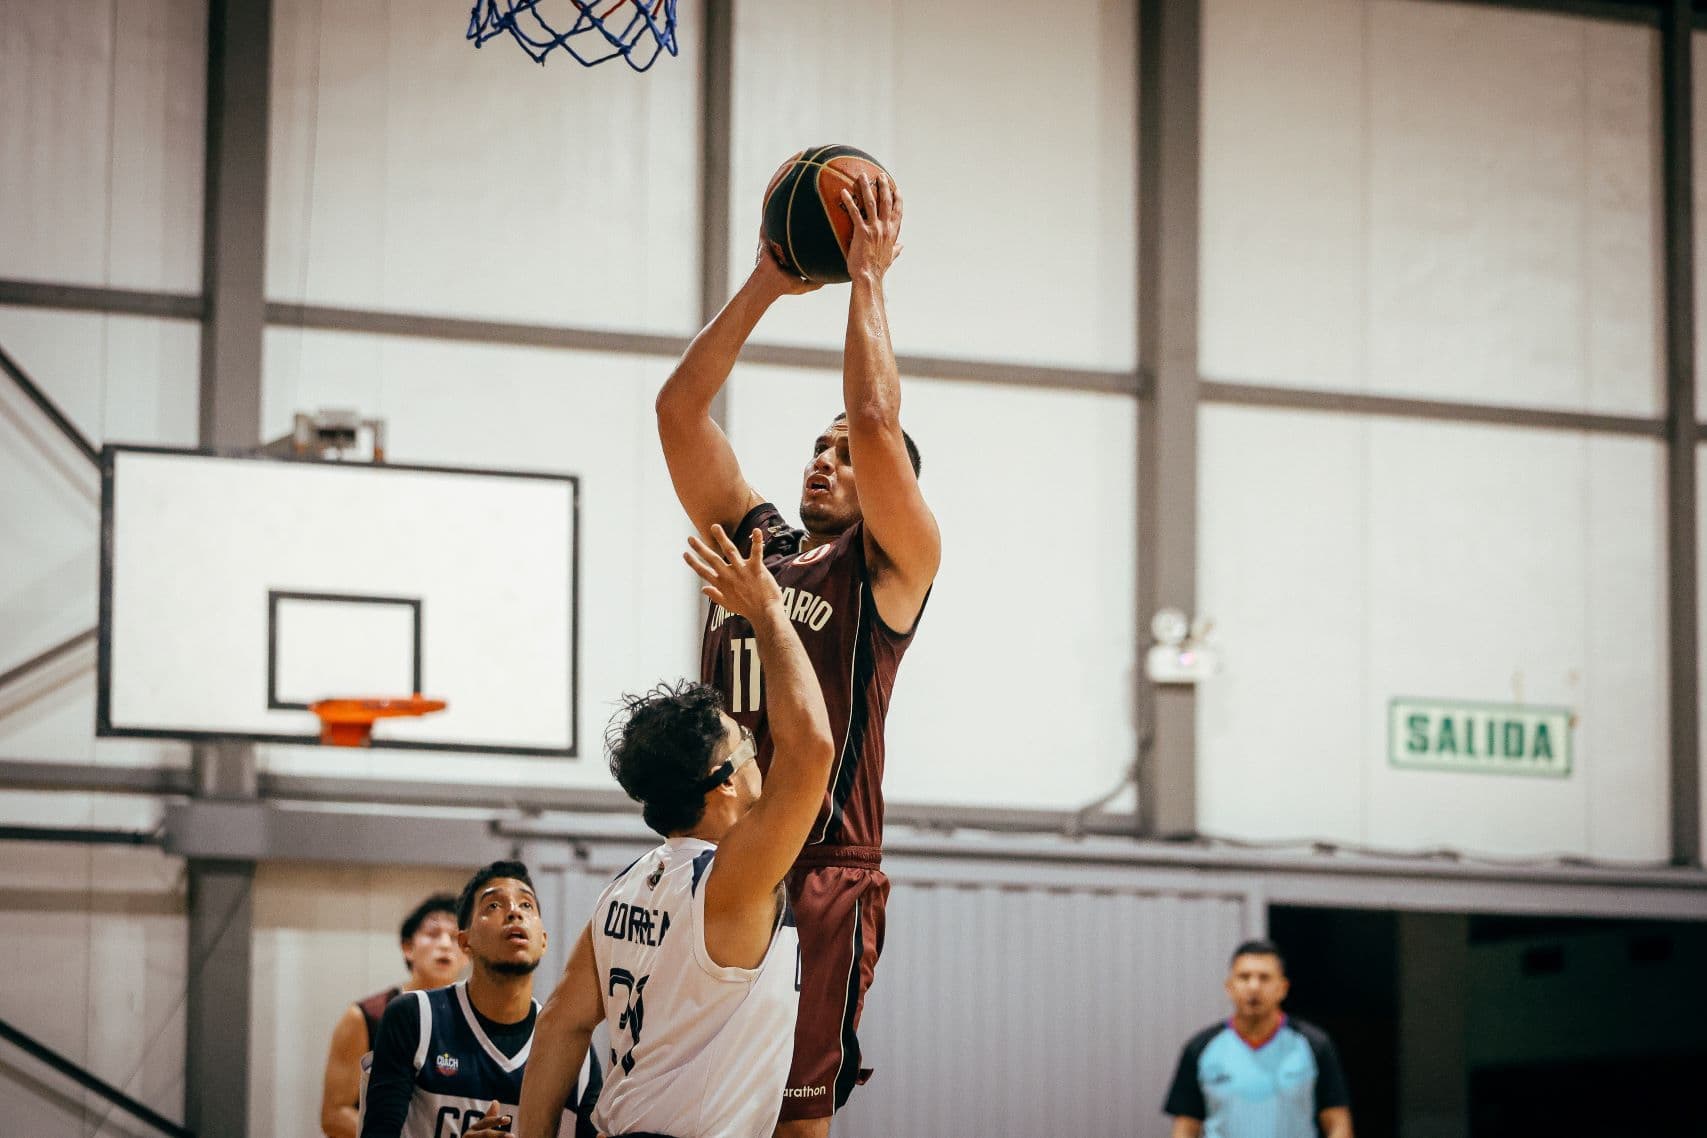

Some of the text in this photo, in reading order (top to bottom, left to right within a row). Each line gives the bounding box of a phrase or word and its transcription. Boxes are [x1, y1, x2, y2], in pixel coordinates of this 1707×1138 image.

[731, 637, 761, 713] 11
[1407, 715, 1552, 759] SALIDA
[783, 1085, 826, 1098] arathon
